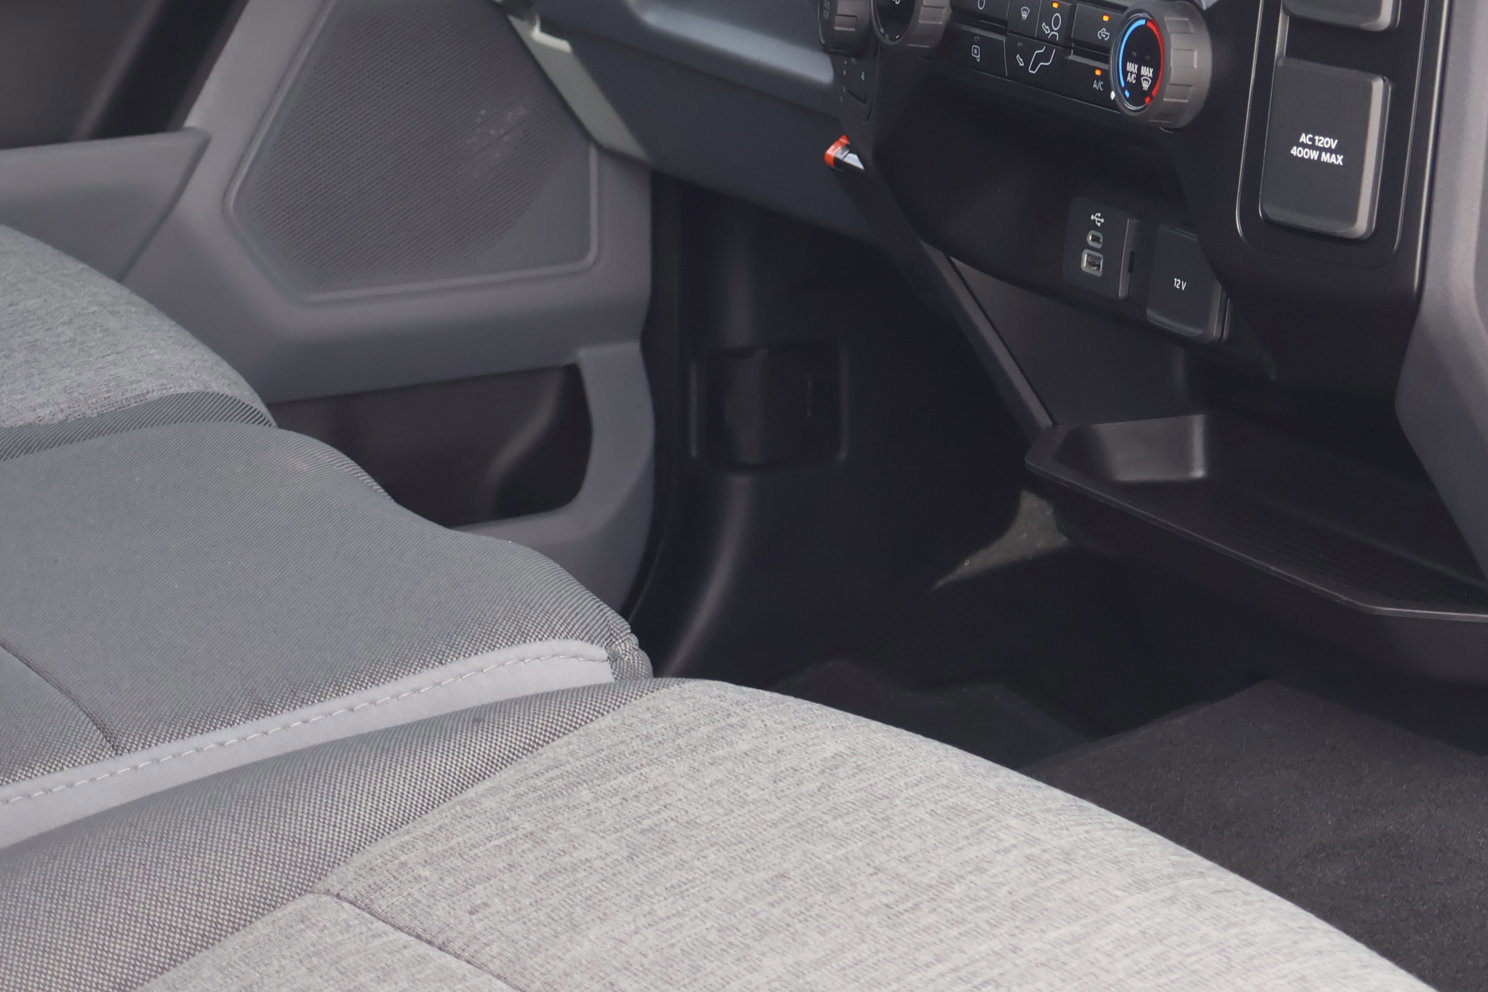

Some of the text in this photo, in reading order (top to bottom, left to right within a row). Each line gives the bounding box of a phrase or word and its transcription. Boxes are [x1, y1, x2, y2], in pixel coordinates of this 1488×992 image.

[1126, 61, 1139, 74] MAX
[1140, 66, 1154, 78] MAX
[1126, 72, 1137, 84] A/C
[1092, 80, 1104, 91] A/C
[1299, 133, 1338, 150] AC 120V
[1290, 146, 1344, 166] 400W MAX
[1173, 278, 1187, 291] 12 V
